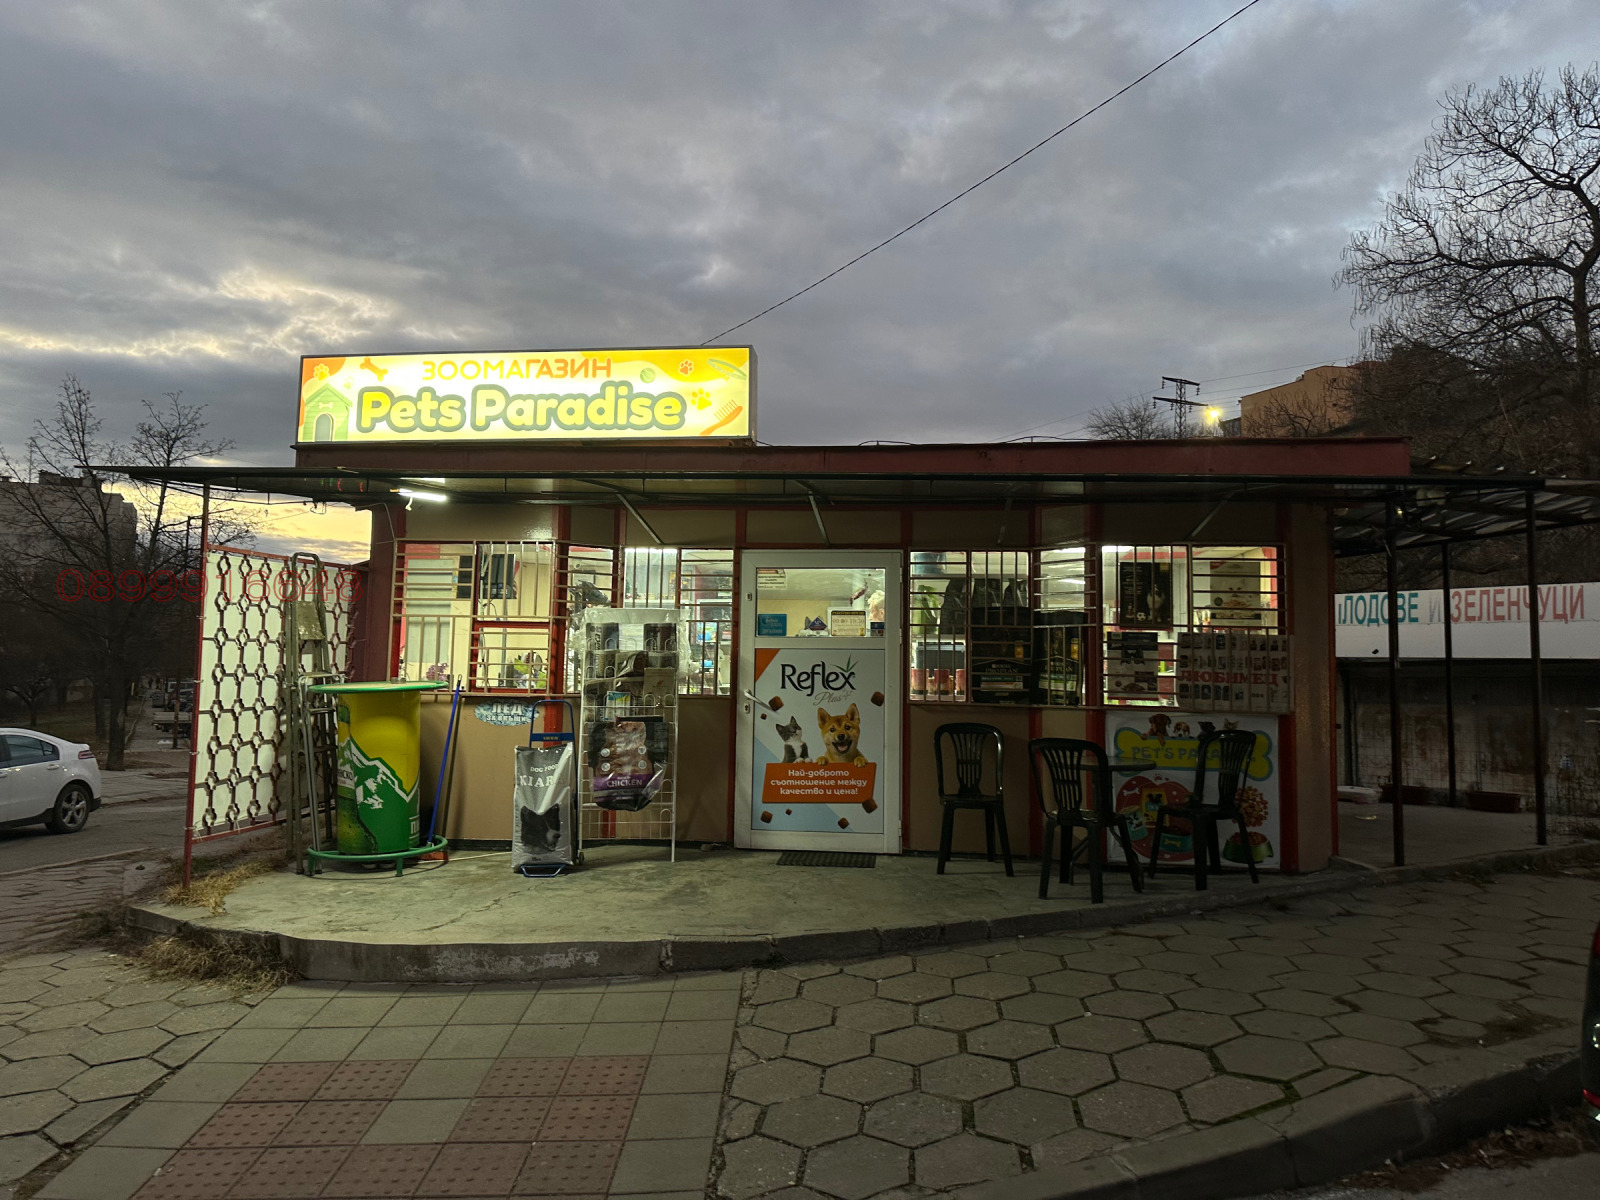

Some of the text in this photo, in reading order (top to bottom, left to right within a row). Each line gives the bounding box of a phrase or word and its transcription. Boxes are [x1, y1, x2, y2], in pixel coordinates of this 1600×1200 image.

[422, 356, 612, 381] ЗООМАГАЗИН
[358, 382, 685, 431] Pets Paradise
[1338, 592, 1419, 627] ЛОДОВЕ
[780, 661, 856, 696] Reflex
[1177, 670, 1279, 687] ЛЮБИМЕЦ
[492, 703, 523, 715] ЛЕД
[1131, 746, 1175, 760] PET'S
[788, 769, 850, 777] Най-доброто
[606, 779, 643, 788] CHICKEN
[837, 778, 868, 788] между
[779, 786, 825, 795] качество
[833, 787, 859, 796] цена!
